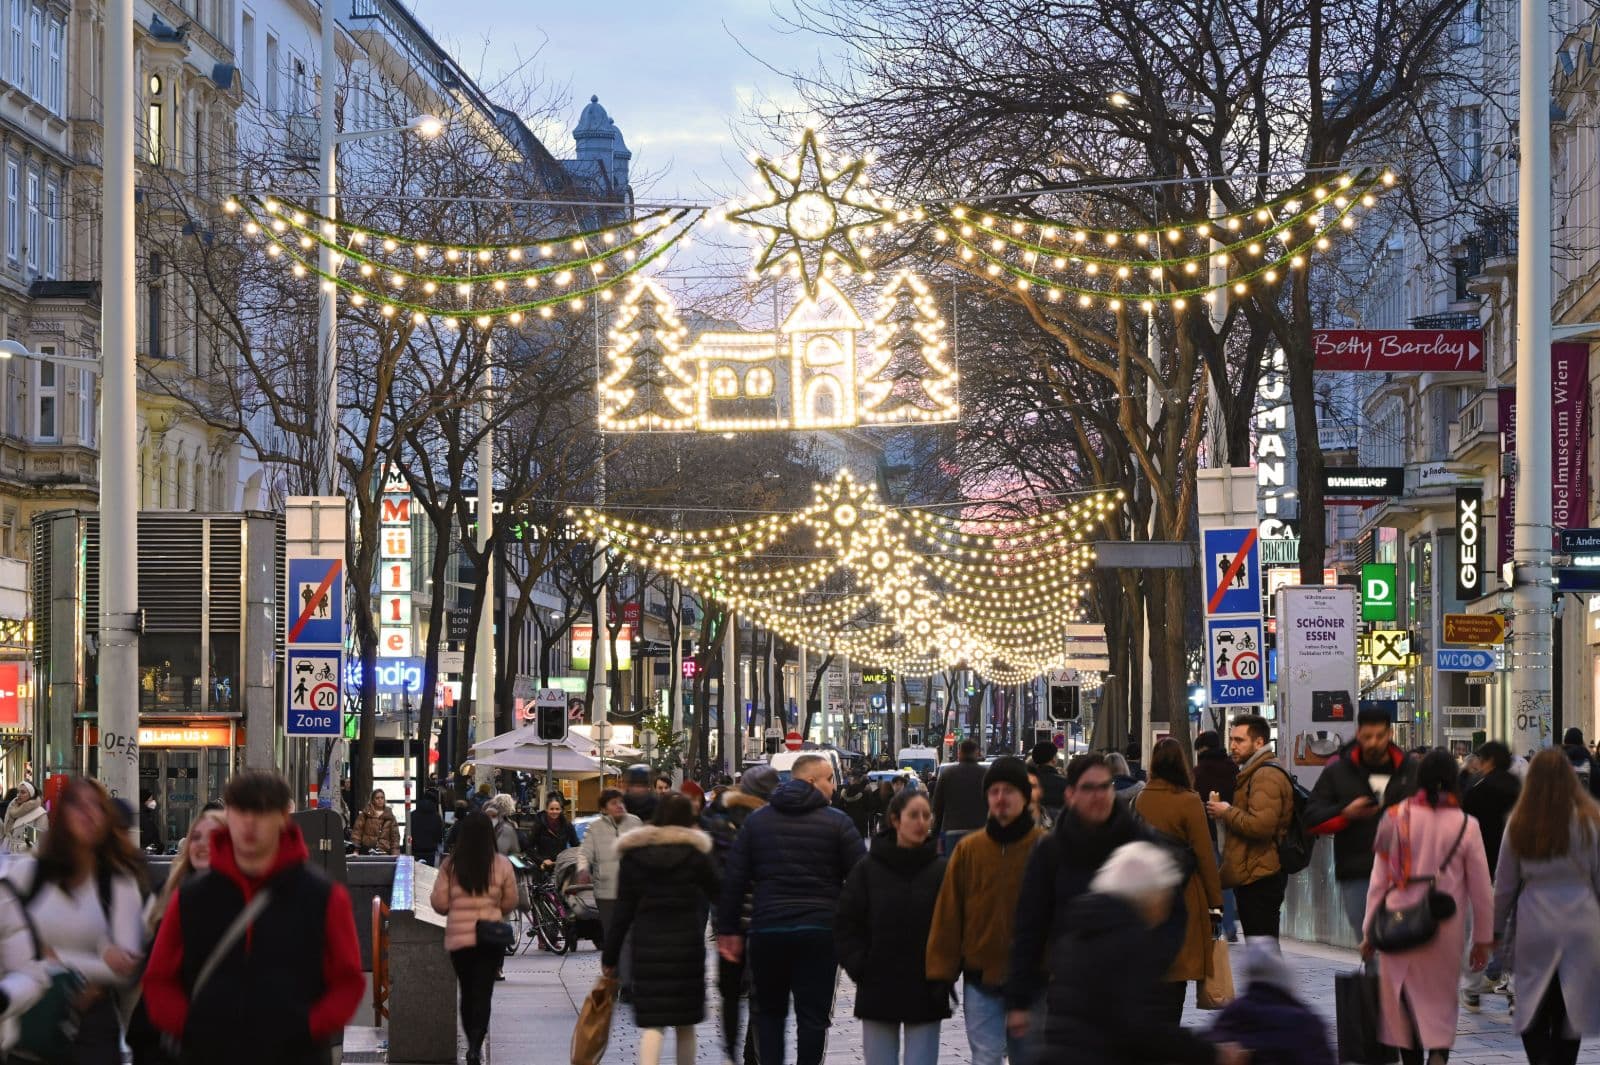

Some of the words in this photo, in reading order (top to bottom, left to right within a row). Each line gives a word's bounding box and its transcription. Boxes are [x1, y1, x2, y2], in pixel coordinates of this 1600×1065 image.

[1313, 334, 1372, 369] Betty
[1379, 333, 1464, 370] Barclay
[1554, 359, 1568, 404] Wien
[1460, 499, 1478, 589] GEOX
[1368, 579, 1389, 600] D
[1296, 615, 1345, 628] SCHÖNER
[1306, 631, 1336, 641] ESSEN
[1439, 654, 1458, 666] WC
[1240, 661, 1256, 675] 20
[1220, 684, 1254, 697] Zone
[318, 691, 334, 706] 20
[296, 714, 331, 727] Zone
